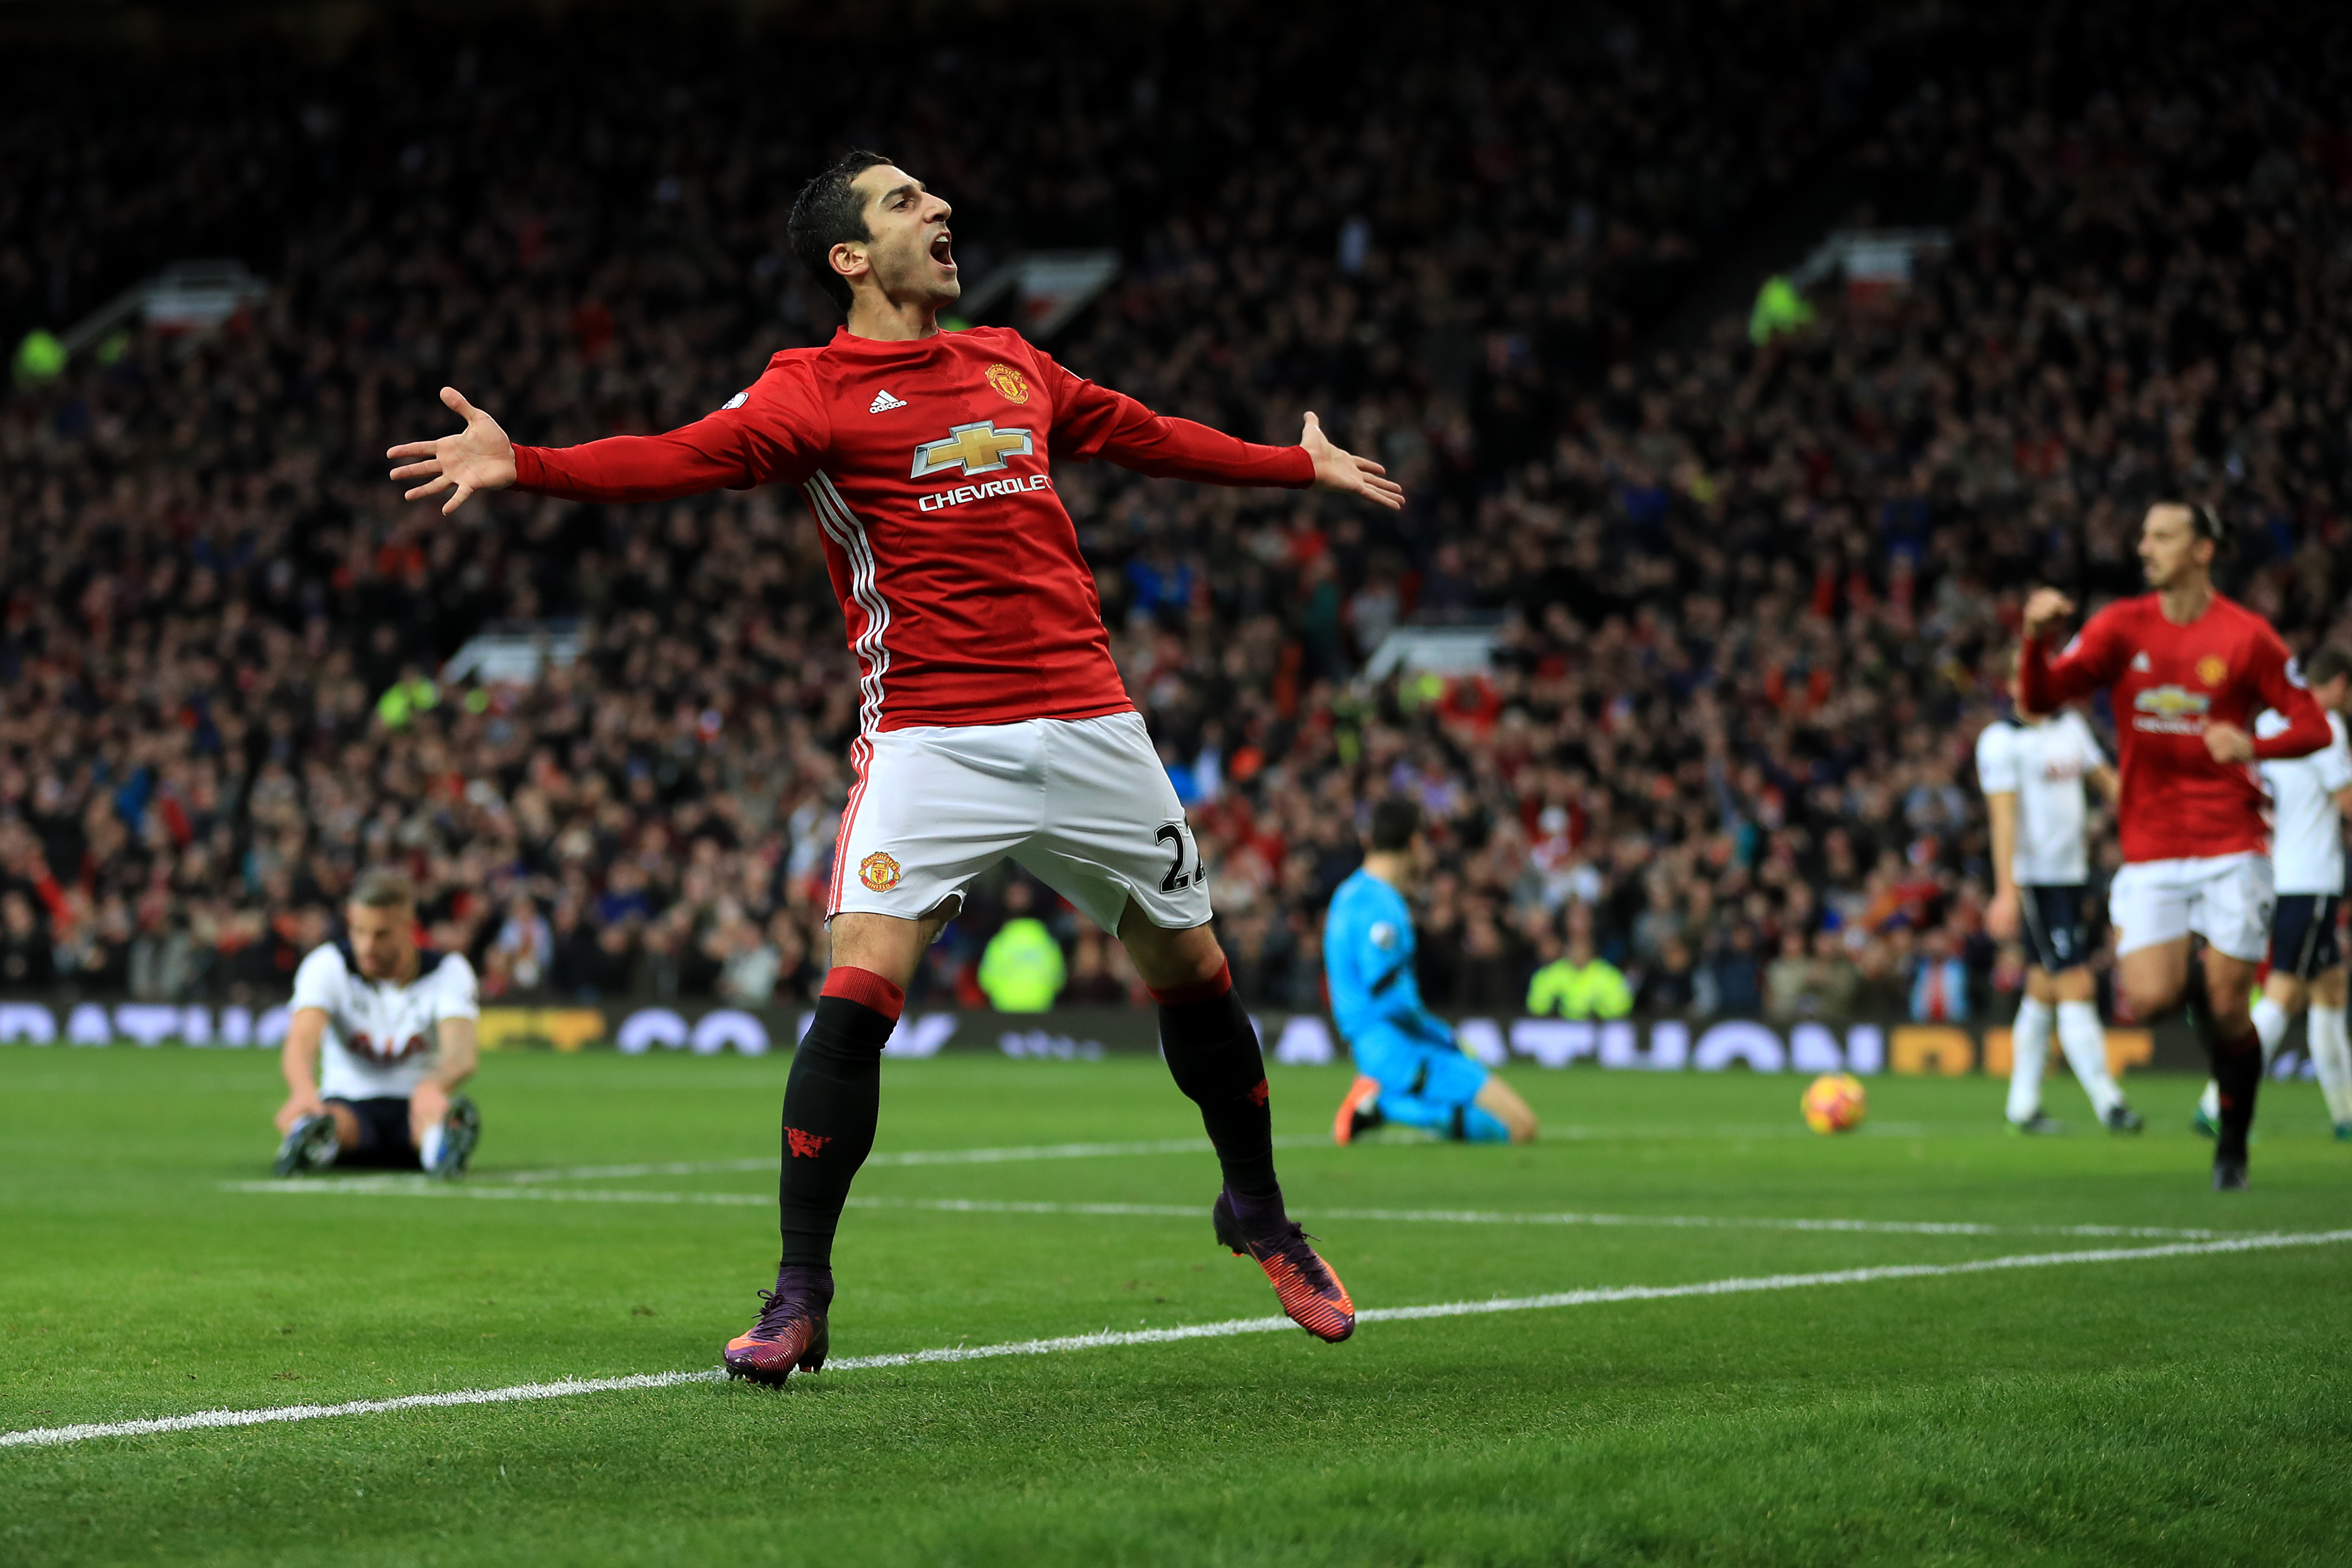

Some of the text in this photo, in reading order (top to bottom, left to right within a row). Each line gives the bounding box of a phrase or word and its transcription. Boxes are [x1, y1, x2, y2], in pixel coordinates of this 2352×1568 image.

[869, 400, 908, 414] adidas
[918, 474, 1052, 512] CHEVROLET
[863, 854, 897, 870] MANCHESTER
[866, 881, 891, 889] UNITED
